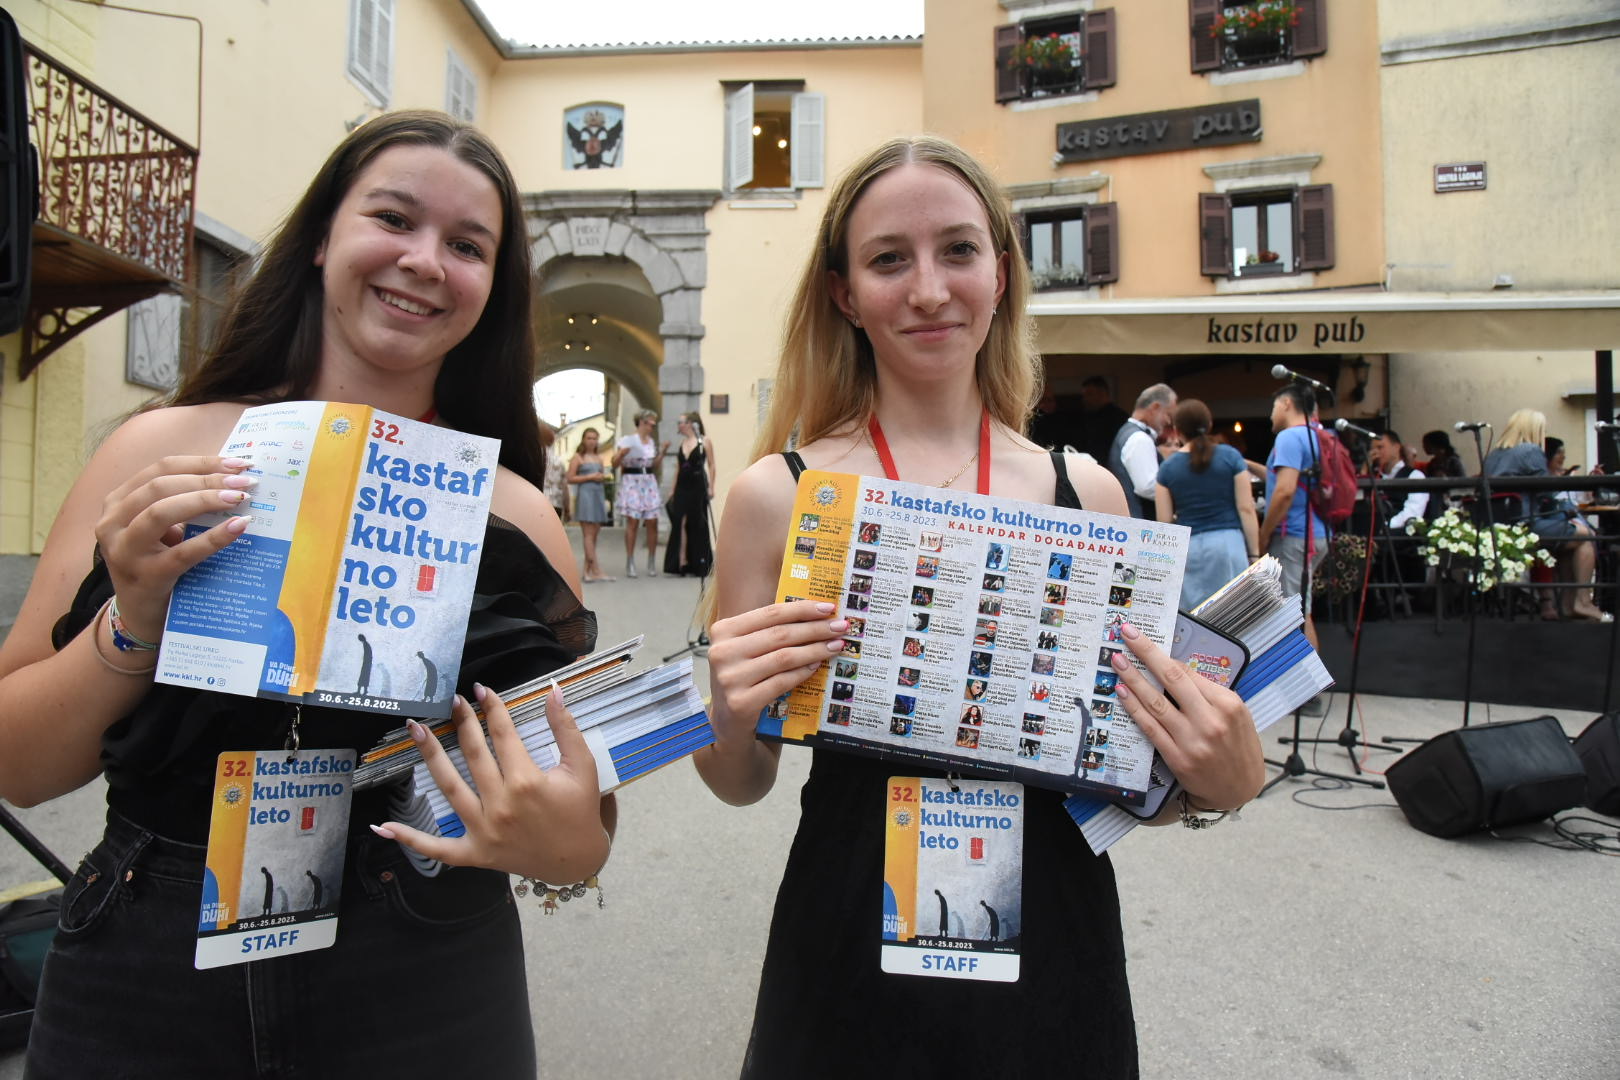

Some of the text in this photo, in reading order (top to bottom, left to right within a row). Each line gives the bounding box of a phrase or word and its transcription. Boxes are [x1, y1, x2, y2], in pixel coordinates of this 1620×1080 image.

[1058, 106, 1258, 150] kastav pub
[1207, 315, 1365, 348] kastav pub
[371, 419, 404, 445] 32.
[365, 442, 489, 497] kastaf
[357, 482, 427, 521] sko
[864, 488, 1128, 543] 32. kastafsko kulturno leto
[912, 515, 937, 527] 2023
[350, 513, 479, 565] kultur
[948, 520, 1026, 541] KALENDAR
[1034, 534, 1126, 557] DOGAĐANJA
[343, 558, 397, 589] no
[336, 586, 416, 629] leto
[266, 668, 299, 687] DUHI
[319, 693, 400, 710] 30.6.-25.8.2023.
[222, 756, 351, 777] 32. kastafsko
[252, 780, 344, 801] kulturno
[892, 785, 1019, 808] 32. kastafsko
[250, 807, 291, 825] leto
[920, 808, 1012, 830] kulturno
[920, 831, 959, 850] leto
[201, 906, 230, 923] DUHI
[238, 915, 297, 931] 30.6.-25.8.2023.
[883, 920, 908, 934] DUHI
[241, 930, 299, 954] STAFF
[917, 938, 974, 950] 30.6.-25.8.2023.
[922, 954, 978, 973] STAFF
